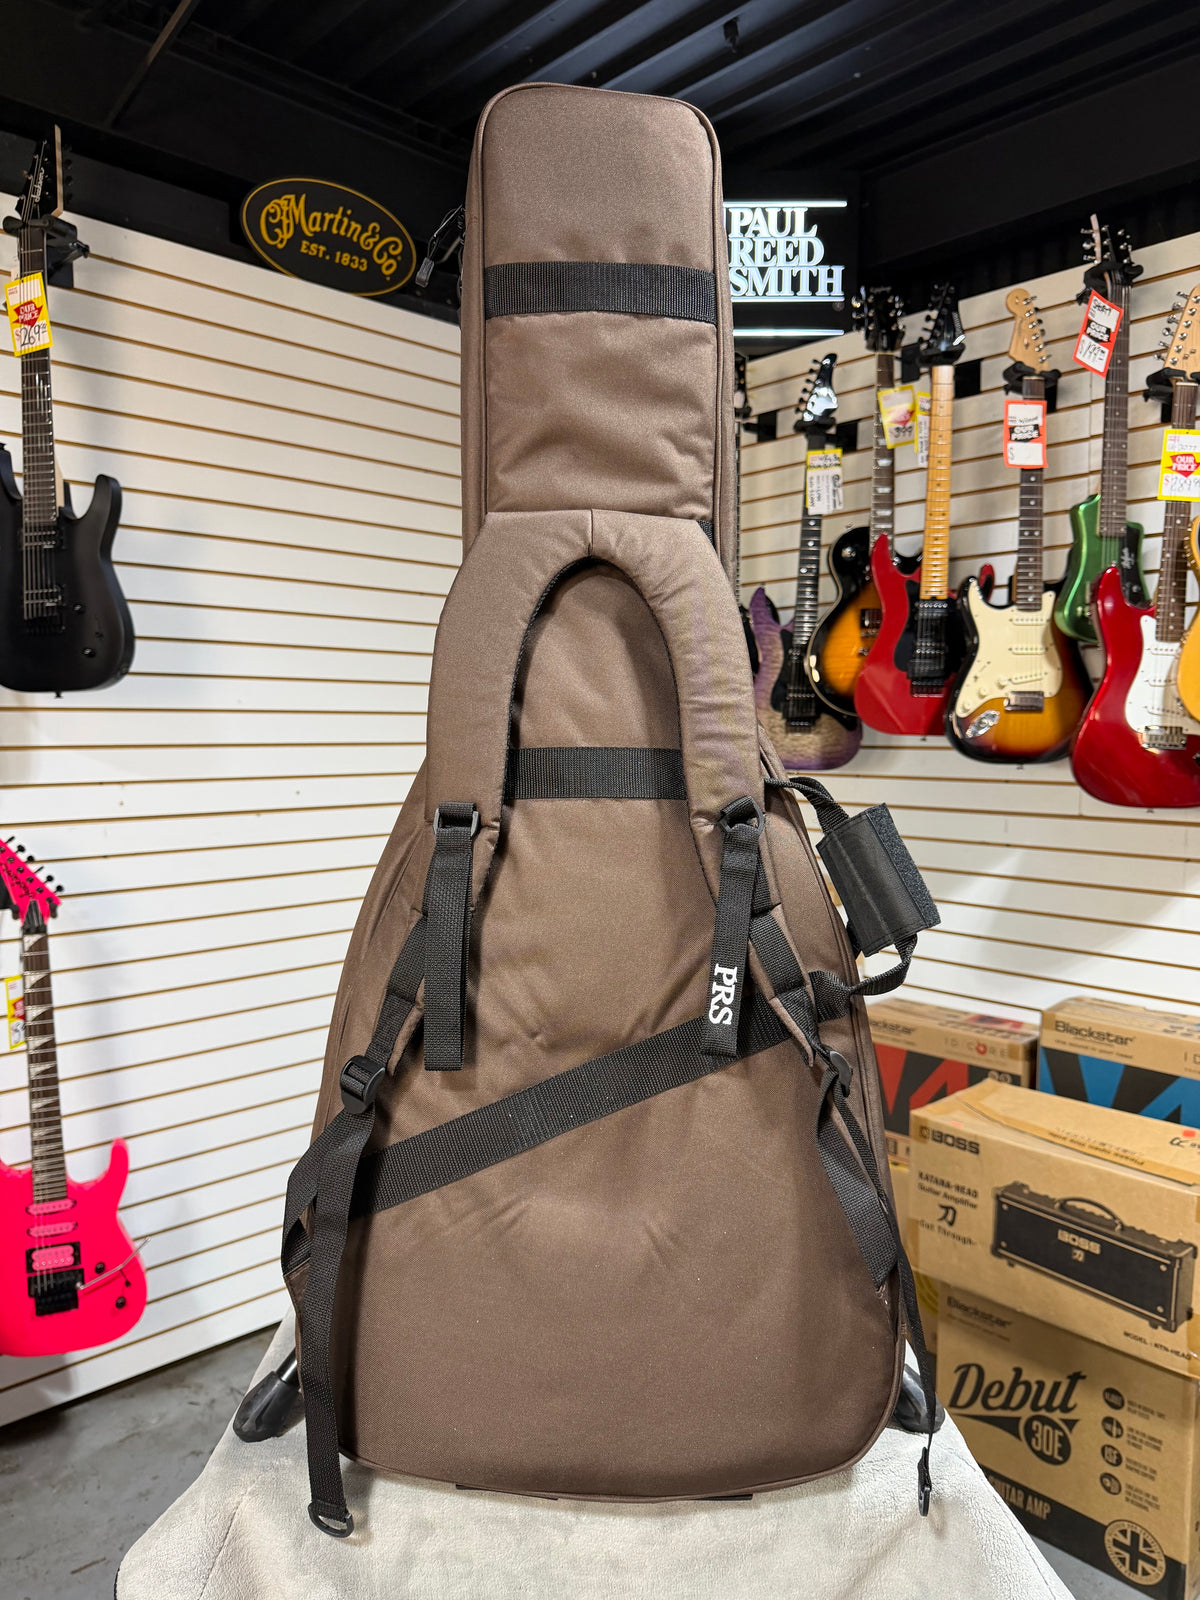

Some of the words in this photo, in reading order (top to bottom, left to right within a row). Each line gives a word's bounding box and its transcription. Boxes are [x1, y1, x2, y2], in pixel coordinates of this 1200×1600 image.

[728, 206, 818, 238] PAUL
[300, 240, 330, 261] EST.
[334, 250, 368, 272] 1833
[728, 236, 825, 267] REED
[729, 265, 845, 297] SMITH
[1175, 454, 1195, 464] OUR
[708, 963, 738, 1025] PRS
[1054, 1019, 1136, 1047] Blackstar
[931, 1129, 980, 1156] BOSS
[948, 1362, 1088, 1414] Debut
[1031, 1420, 1064, 1462] 30E
